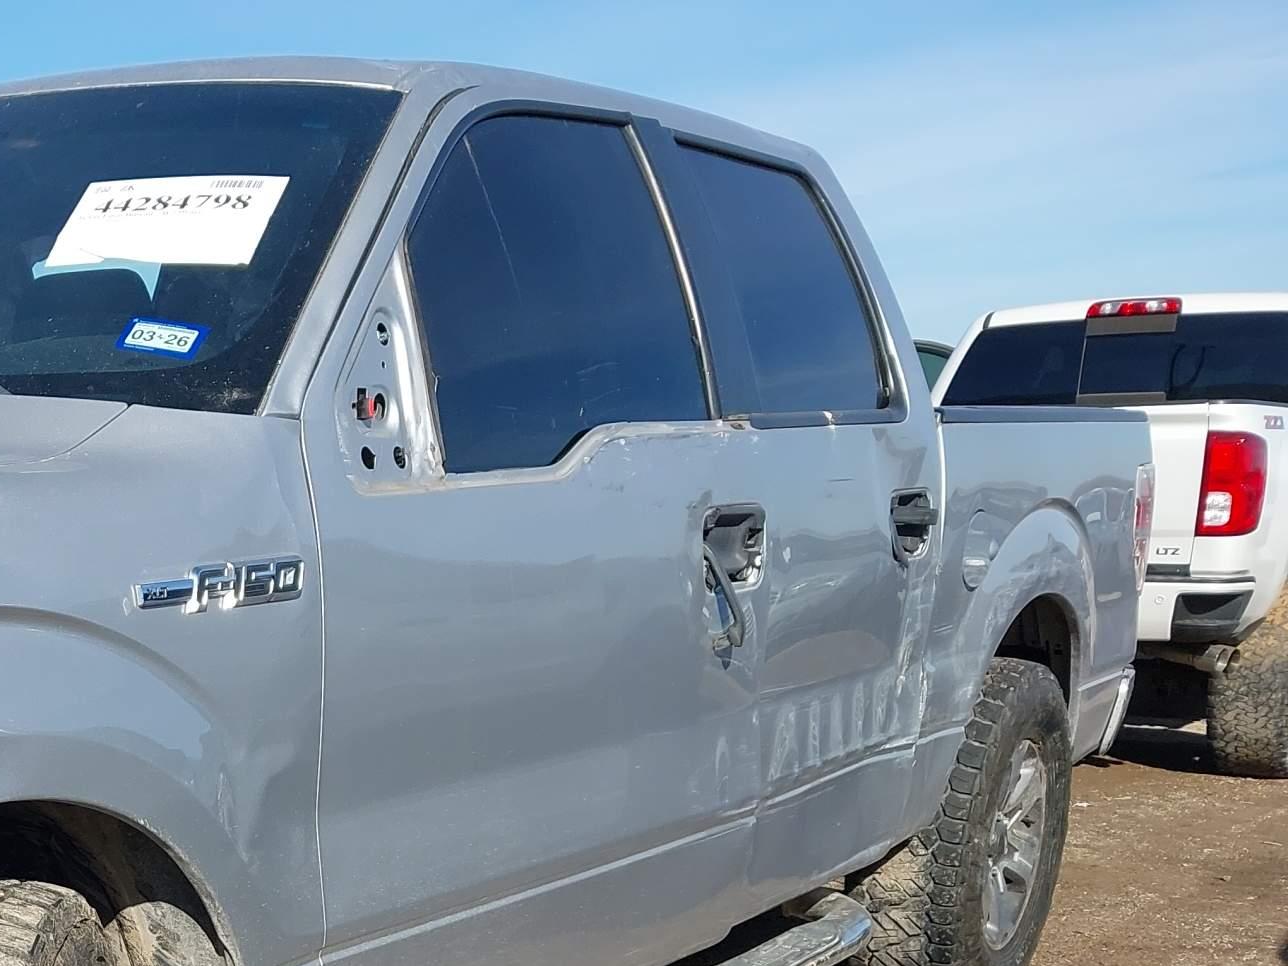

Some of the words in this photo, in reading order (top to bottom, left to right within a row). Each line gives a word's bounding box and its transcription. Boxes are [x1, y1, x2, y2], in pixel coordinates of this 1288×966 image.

[94, 194, 253, 214] 44284798
[132, 329, 156, 342] 03
[164, 333, 190, 347] 26
[1155, 547, 1181, 556] LTZ
